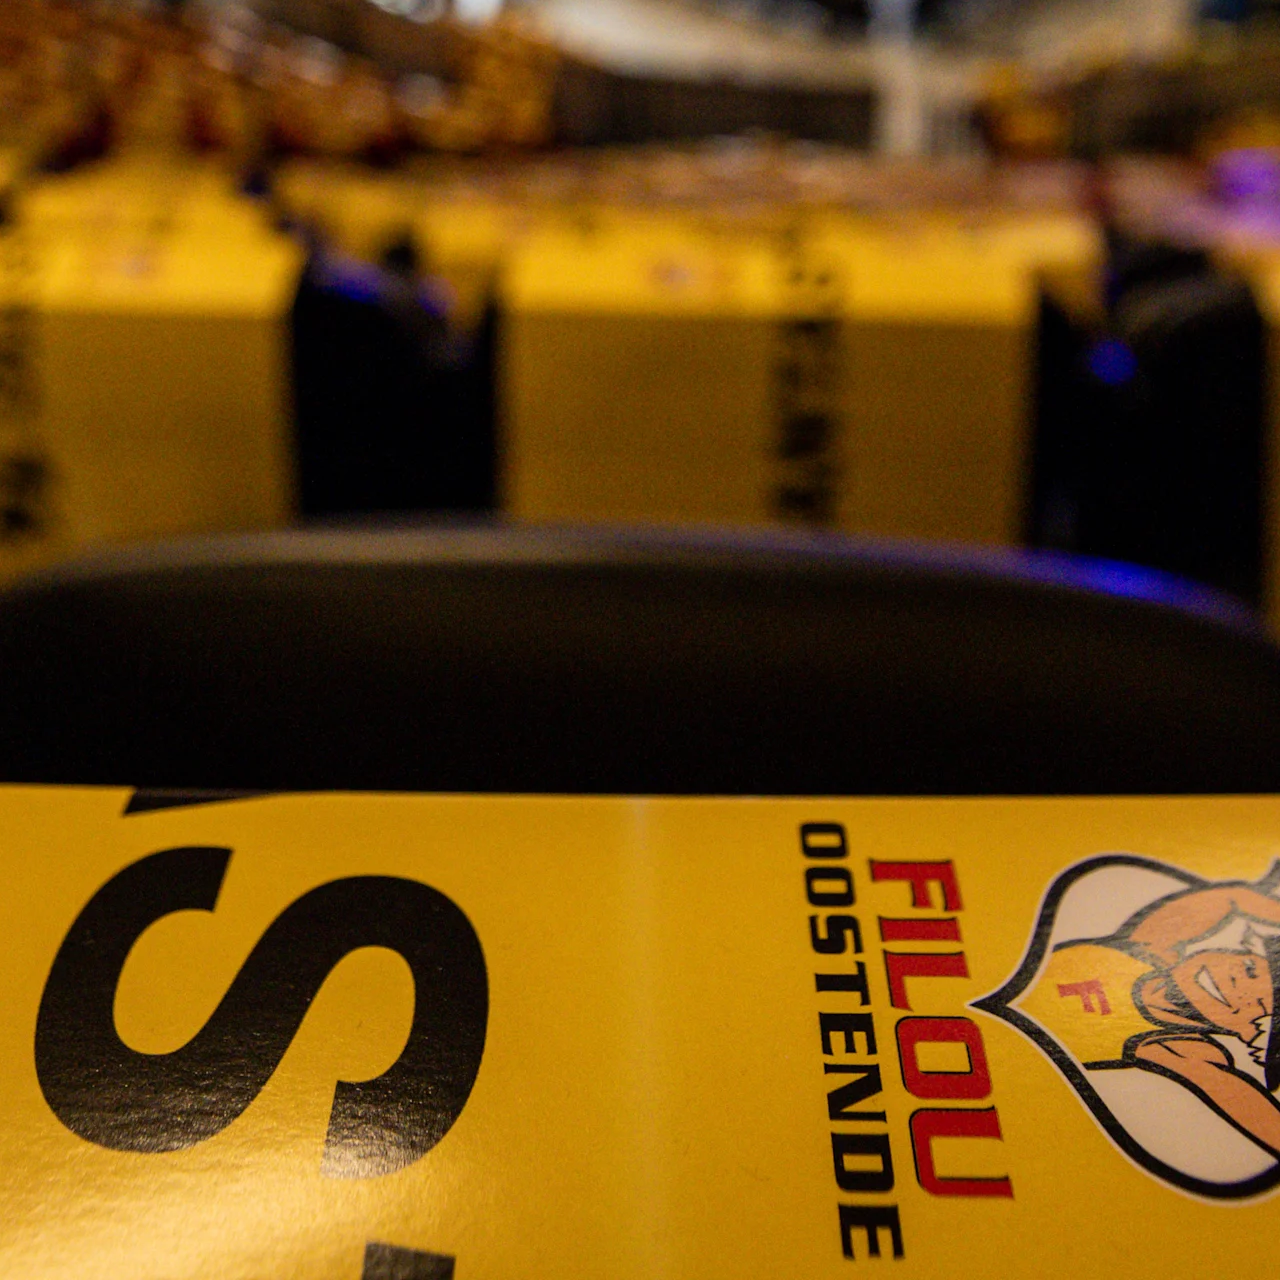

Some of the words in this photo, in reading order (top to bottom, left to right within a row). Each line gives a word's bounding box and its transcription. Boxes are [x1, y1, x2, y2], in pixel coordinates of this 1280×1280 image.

[800, 821, 906, 1262] OOSTENDE
[868, 858, 1015, 1201] FILOU
[1057, 979, 1113, 1017] F
